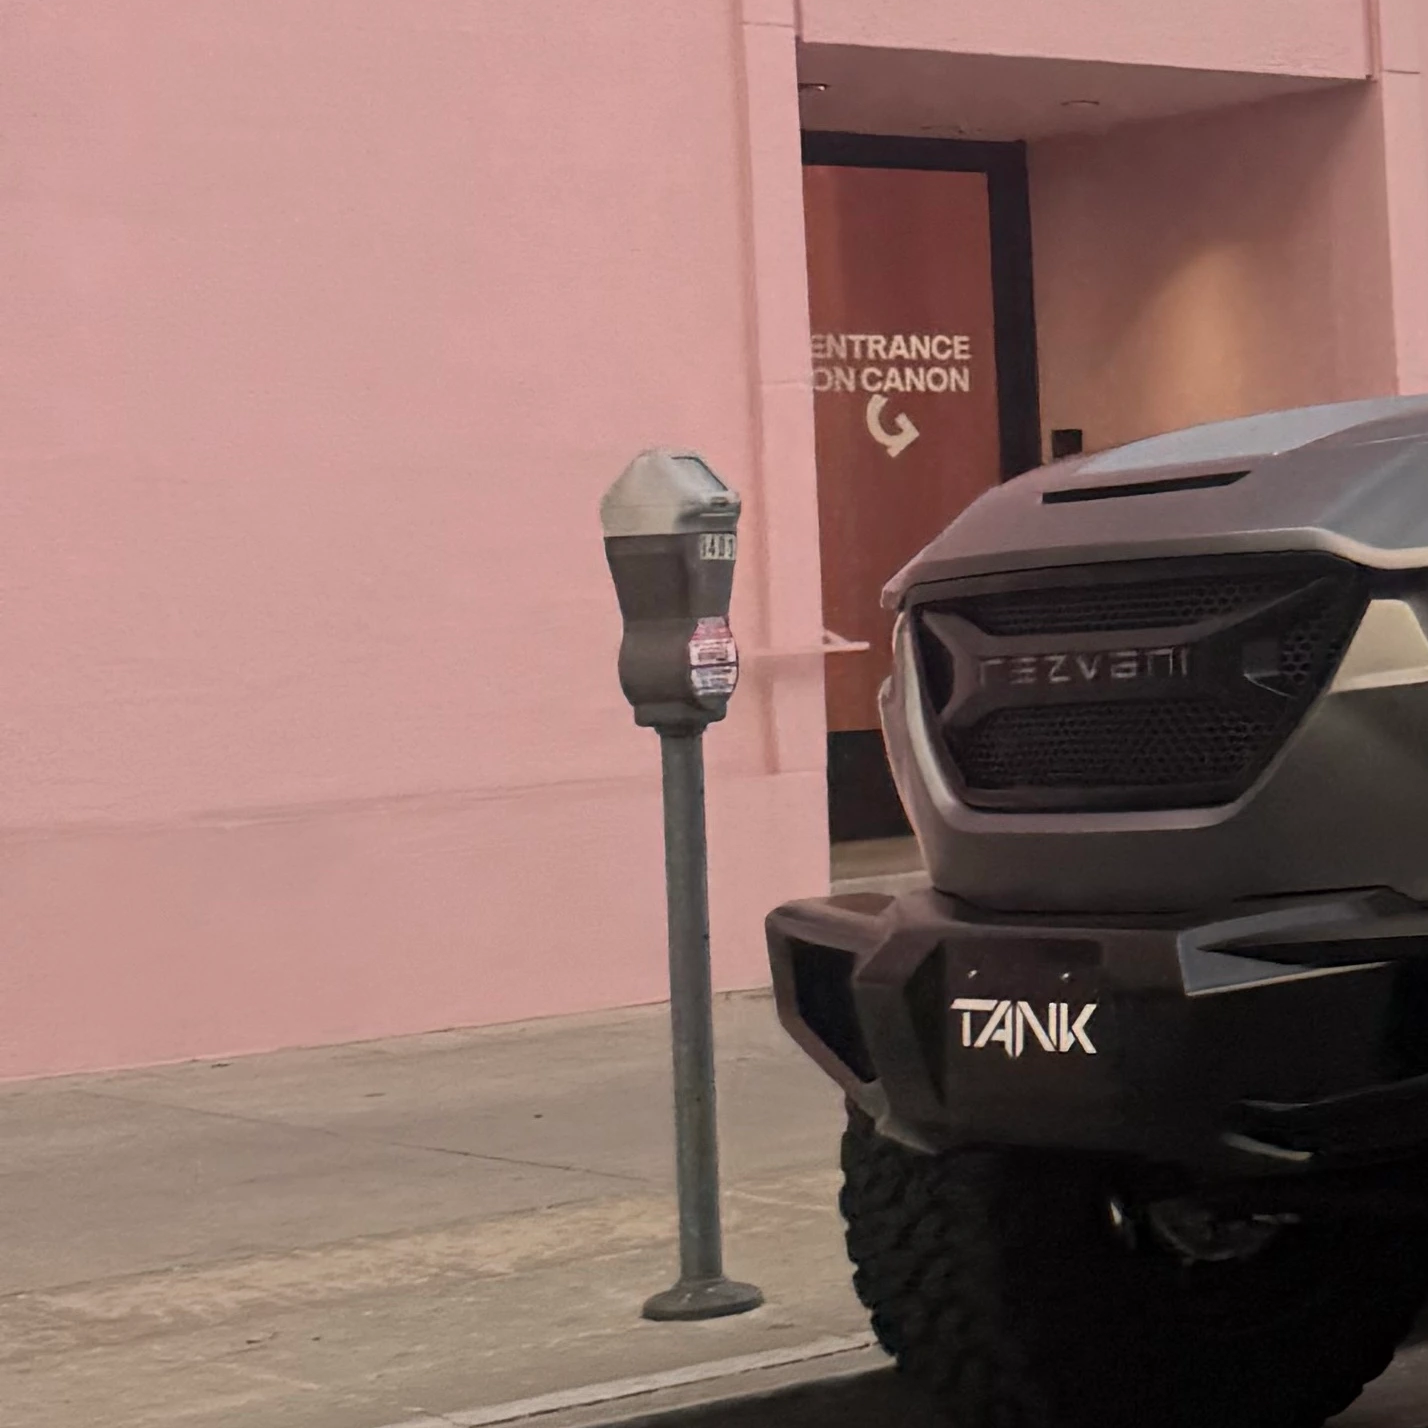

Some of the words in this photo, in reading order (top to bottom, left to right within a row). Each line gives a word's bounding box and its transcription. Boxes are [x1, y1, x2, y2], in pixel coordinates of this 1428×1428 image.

[811, 334, 972, 360] ENTRANCE
[812, 366, 856, 392] ON
[861, 367, 970, 392] CANON
[950, 998, 1097, 1058] TANK
